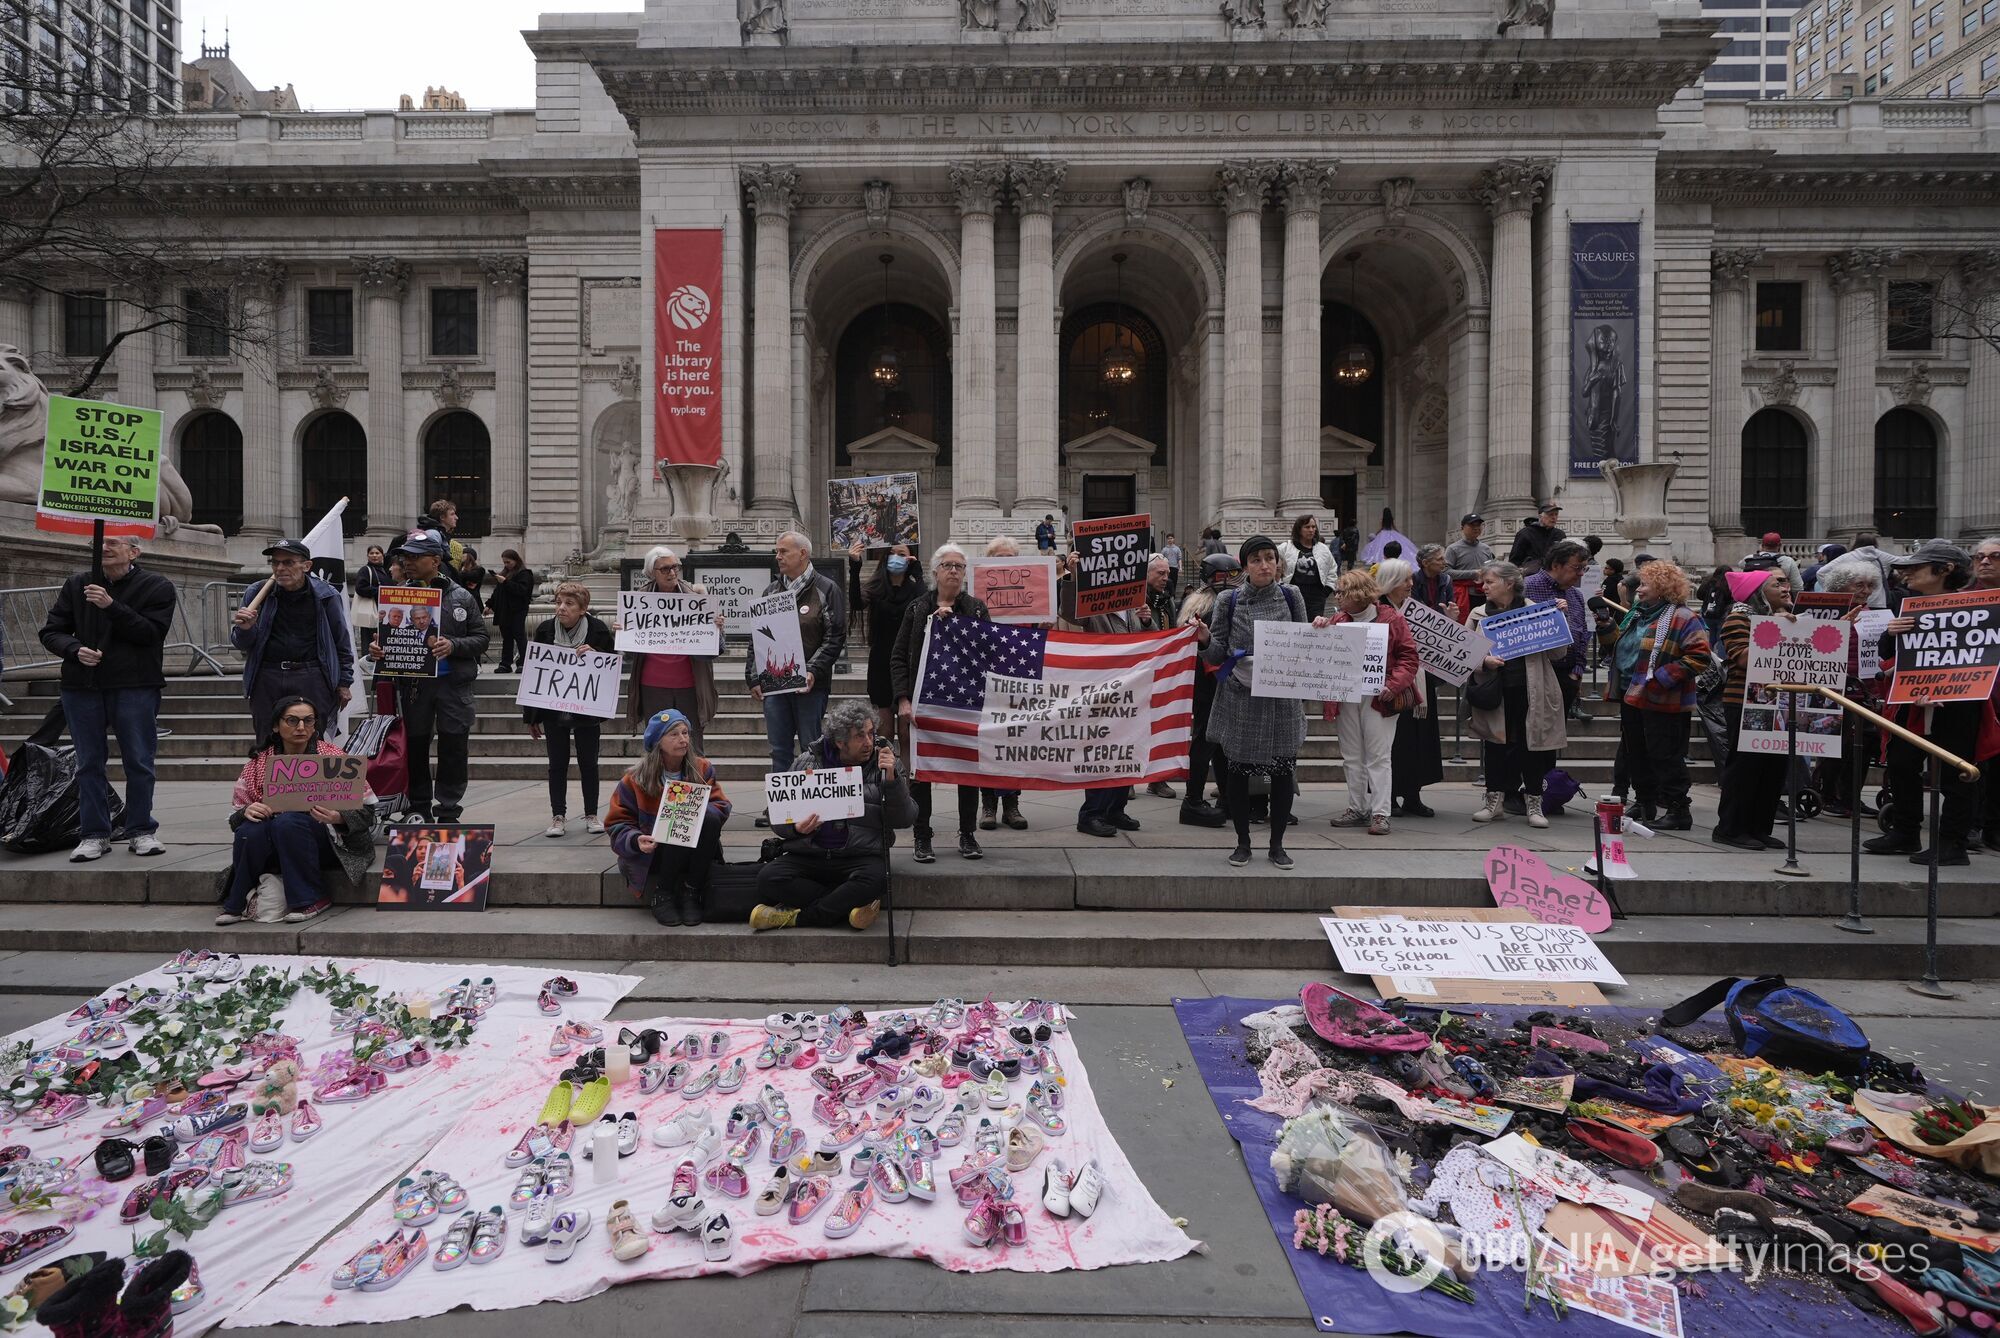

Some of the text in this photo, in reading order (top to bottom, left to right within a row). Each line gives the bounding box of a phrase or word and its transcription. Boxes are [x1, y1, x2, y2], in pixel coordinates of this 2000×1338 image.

[902, 116, 957, 135] THE
[977, 115, 1042, 135] NEW
[1066, 115, 1135, 135] YORK
[1157, 113, 1252, 133] PUBLIC
[1275, 113, 1388, 132] LIBRARY
[1574, 252, 1635, 262] TREASURES
[676, 340, 701, 352] The
[664, 354, 712, 370] Library
[667, 369, 710, 381] is here
[662, 383, 714, 399] for you.
[75, 407, 143, 427] STOP
[670, 405, 706, 417] nypl.org
[80, 425, 136, 444] U.S./
[60, 439, 154, 462] ISRAELI
[54, 457, 150, 479] WAR ON
[1574, 461, 1591, 469] FREE
[71, 476, 132, 494] IRAN
[60, 493, 138, 508] WORKERS.ORG
[45, 501, 152, 518] WORKERS WORLD PARTY
[1079, 520, 1146, 533] RefuseFascism.org
[1091, 534, 1139, 554] STOP
[1080, 548, 1149, 572] WAR ON
[702, 574, 741, 585] Explore
[986, 569, 1032, 587] STOP
[1090, 566, 1136, 587] IRAN!
[739, 586, 754, 596] On
[985, 590, 1035, 607] KILLING
[1081, 584, 1145, 604] TRUMP MUST
[623, 594, 652, 610] U.S.
[657, 598, 683, 612] OUT
[688, 598, 707, 612] OF
[728, 599, 738, 607] at
[750, 602, 767, 618] NOT
[1090, 597, 1133, 612] GO NOW!
[623, 611, 715, 632] EVERYWHERE
[1403, 601, 1469, 642] BOMBING
[1919, 609, 1990, 630] STOP
[390, 628, 420, 637] FASCIST
[635, 630, 646, 639] NO
[648, 630, 668, 638] BOOTS
[1496, 618, 1555, 640] NEGOTIATION
[386, 637, 424, 646] GENOCIDAL
[1497, 641, 1505, 649] &
[1508, 626, 1560, 646] DIPLOMACY
[1902, 627, 2000, 650] WAR ON
[382, 645, 428, 655] IMPERIALISTS
[529, 645, 618, 671] HANDS OFF
[1456, 648, 1471, 660] IS
[1778, 645, 1813, 659] LOVE
[1860, 650, 1876, 658] NOT
[1915, 648, 1985, 667] IRAN!
[1418, 647, 1473, 676] FEMINIST
[1753, 657, 1848, 673] AND CONCERN
[528, 666, 601, 702] IRAN
[1772, 669, 1840, 685] FOR IRAN
[1900, 671, 1992, 686] TRUMP MUST
[991, 677, 1122, 698] THERE IS NO FLAG
[1909, 684, 1971, 697] GO NOW!
[1009, 690, 1134, 711] LARGE ENOUGH
[990, 711, 1007, 724] TO
[1057, 706, 1083, 719] THE
[1087, 706, 1138, 719] SHAME
[1006, 724, 1111, 742] OF KILLING
[994, 744, 1135, 763] INNOCENT PEOPLE
[271, 757, 319, 782] NO
[1074, 763, 1141, 774] HOWARD ZINN
[771, 772, 838, 788] STOP THE
[267, 781, 353, 797] DOMINATION
[767, 789, 797, 802] WAR
[306, 793, 352, 802] CODE PINK
[674, 809, 699, 817] children
[676, 801, 702, 812] healthy
[672, 821, 689, 834] living
[1496, 846, 1536, 866] The
[1490, 858, 1603, 916] Planet
[1526, 895, 1575, 918] needs
[1330, 922, 1371, 934] THE
[1418, 923, 1449, 933] AND
[1510, 924, 1587, 944] BOMBS
[1342, 936, 1458, 948] ISRAEL KILLED
[1499, 941, 1574, 955] ARE NOT
[1354, 949, 1455, 962] 165 SCHOOL
[1380, 962, 1434, 972] GIRLS
